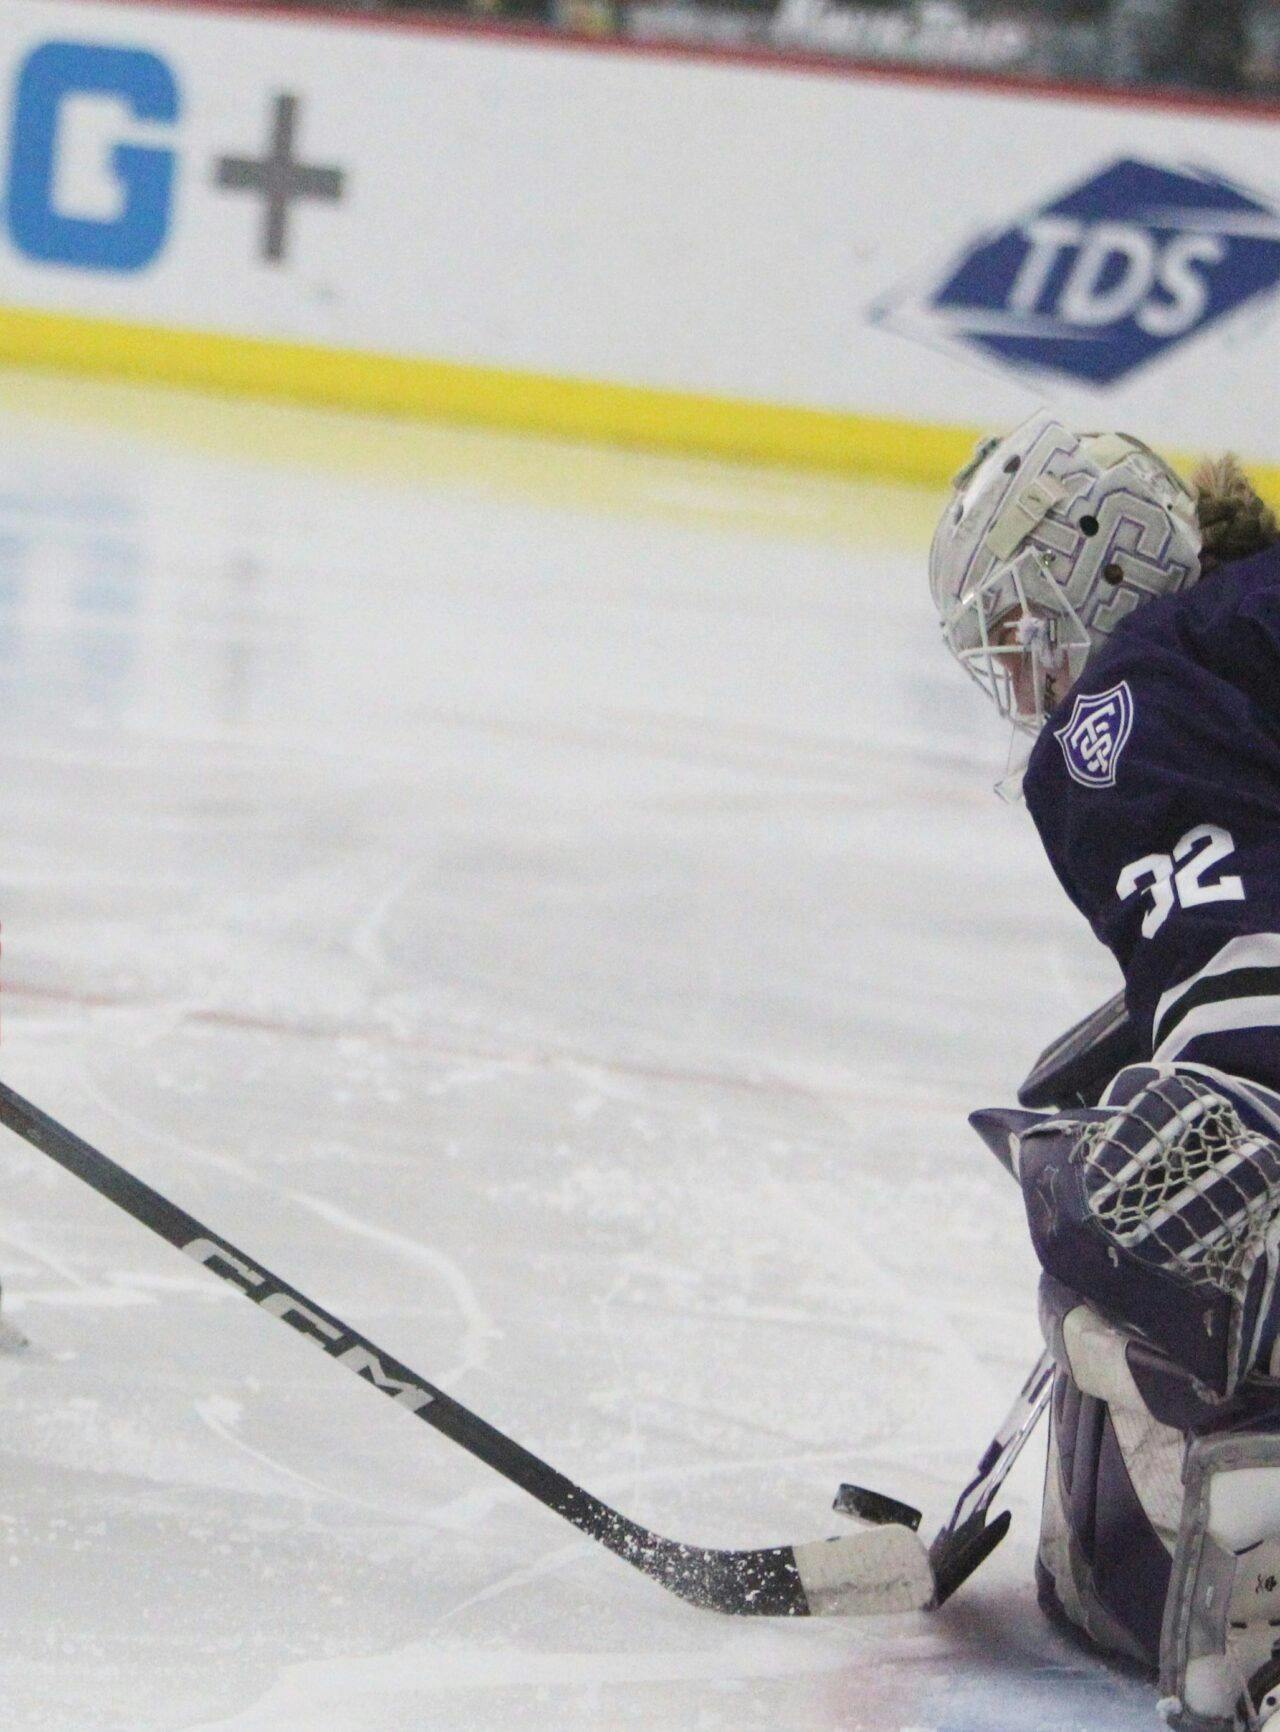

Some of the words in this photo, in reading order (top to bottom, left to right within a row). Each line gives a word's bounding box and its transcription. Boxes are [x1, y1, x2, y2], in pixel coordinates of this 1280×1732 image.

[1006, 218, 1226, 340] TDS
[1116, 823, 1246, 939] 32
[180, 1237, 433, 1411] CCM
